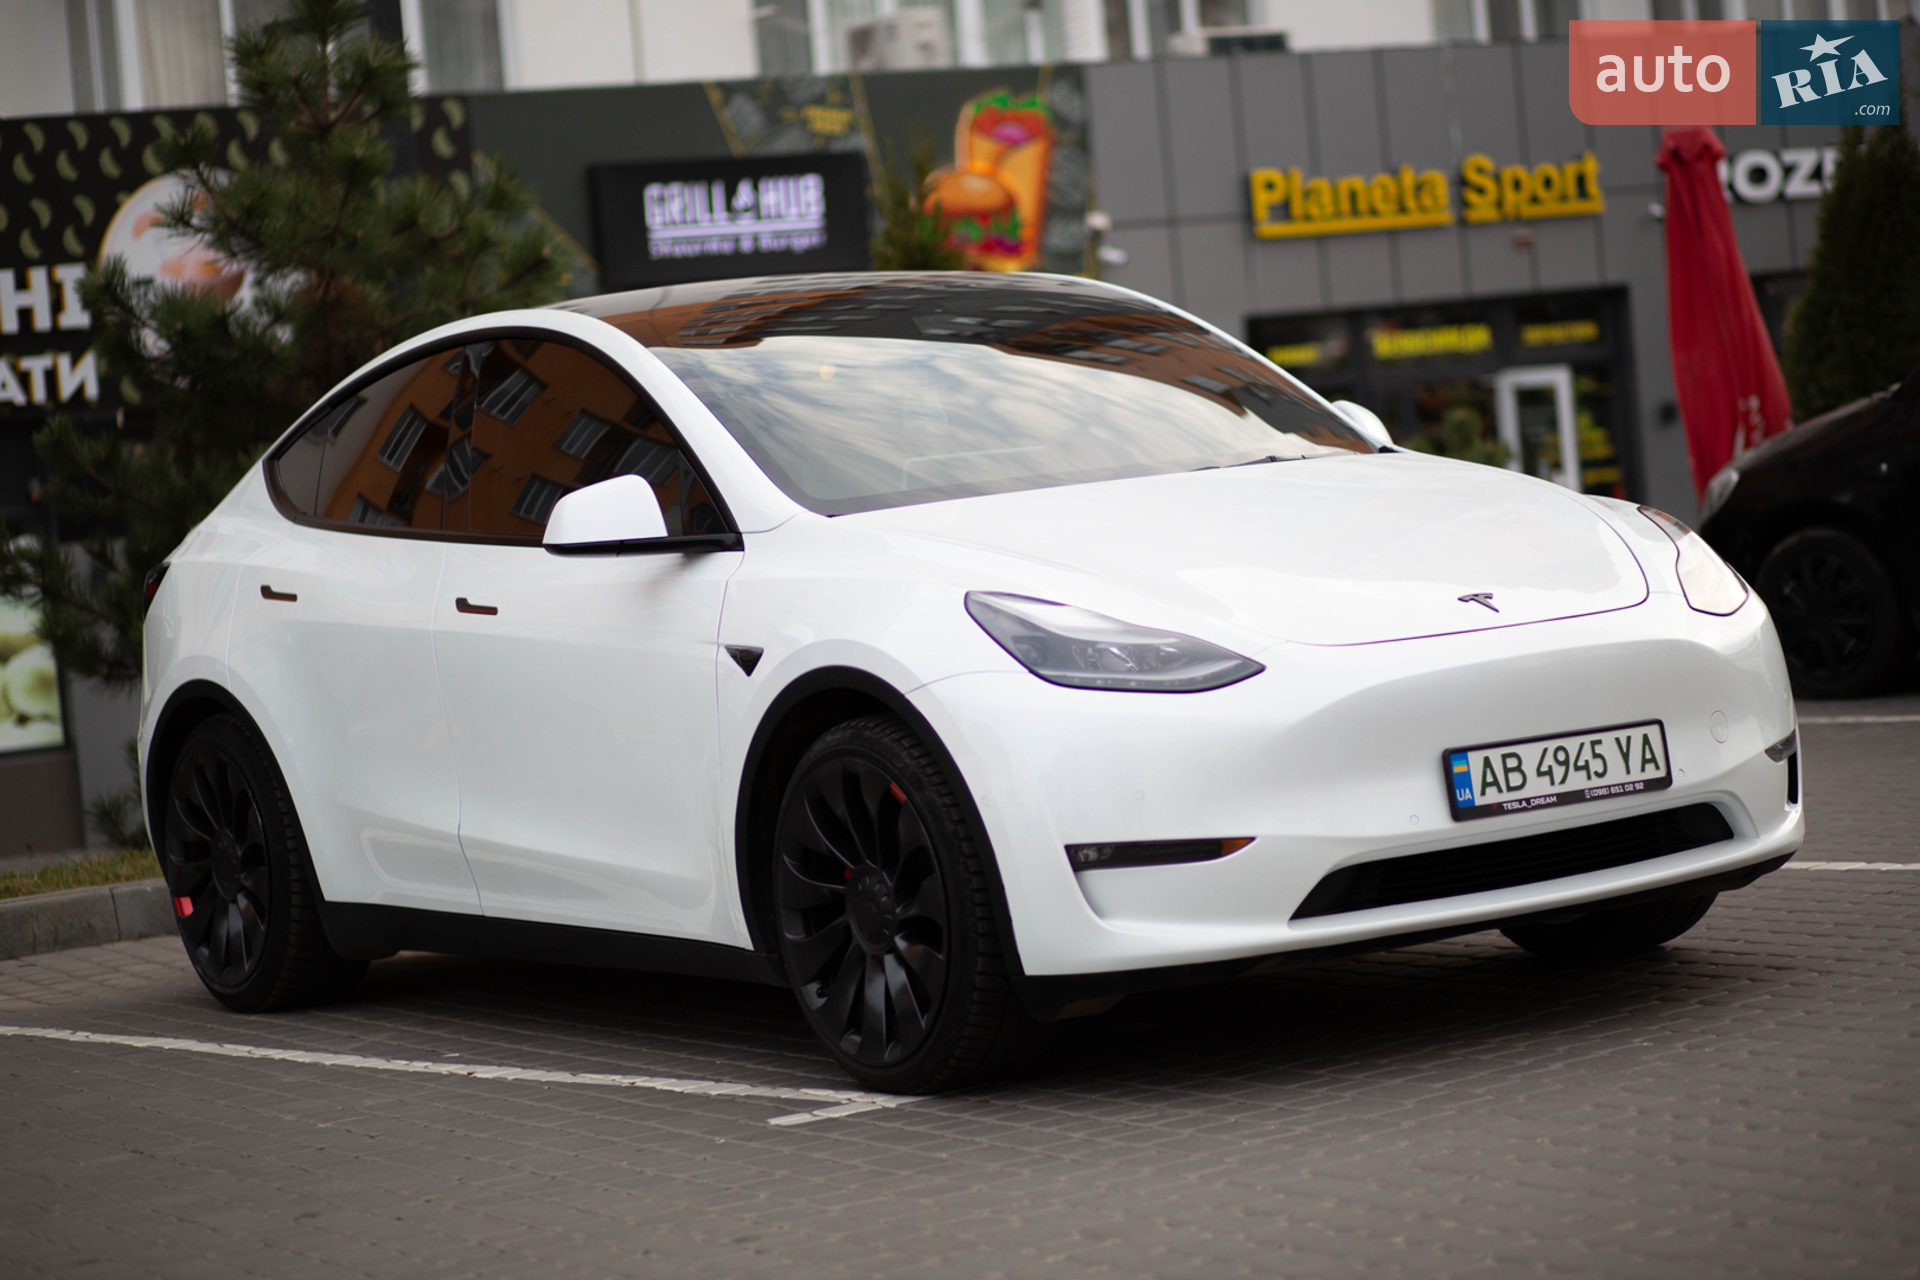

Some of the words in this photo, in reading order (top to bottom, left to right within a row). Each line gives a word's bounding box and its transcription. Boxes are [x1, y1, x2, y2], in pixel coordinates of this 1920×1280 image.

[643, 178, 733, 229] GRILL
[758, 172, 826, 220] HUB
[1250, 162, 1450, 222] Planeta
[1462, 150, 1601, 219] Sport
[1480, 751, 1527, 797] AB
[1536, 739, 1608, 786] 4945
[1614, 733, 1660, 775] YA
[1456, 787, 1473, 801] UA
[1502, 795, 1557, 811] TESLA_DREAM
[1635, 781, 1645, 790] 92
